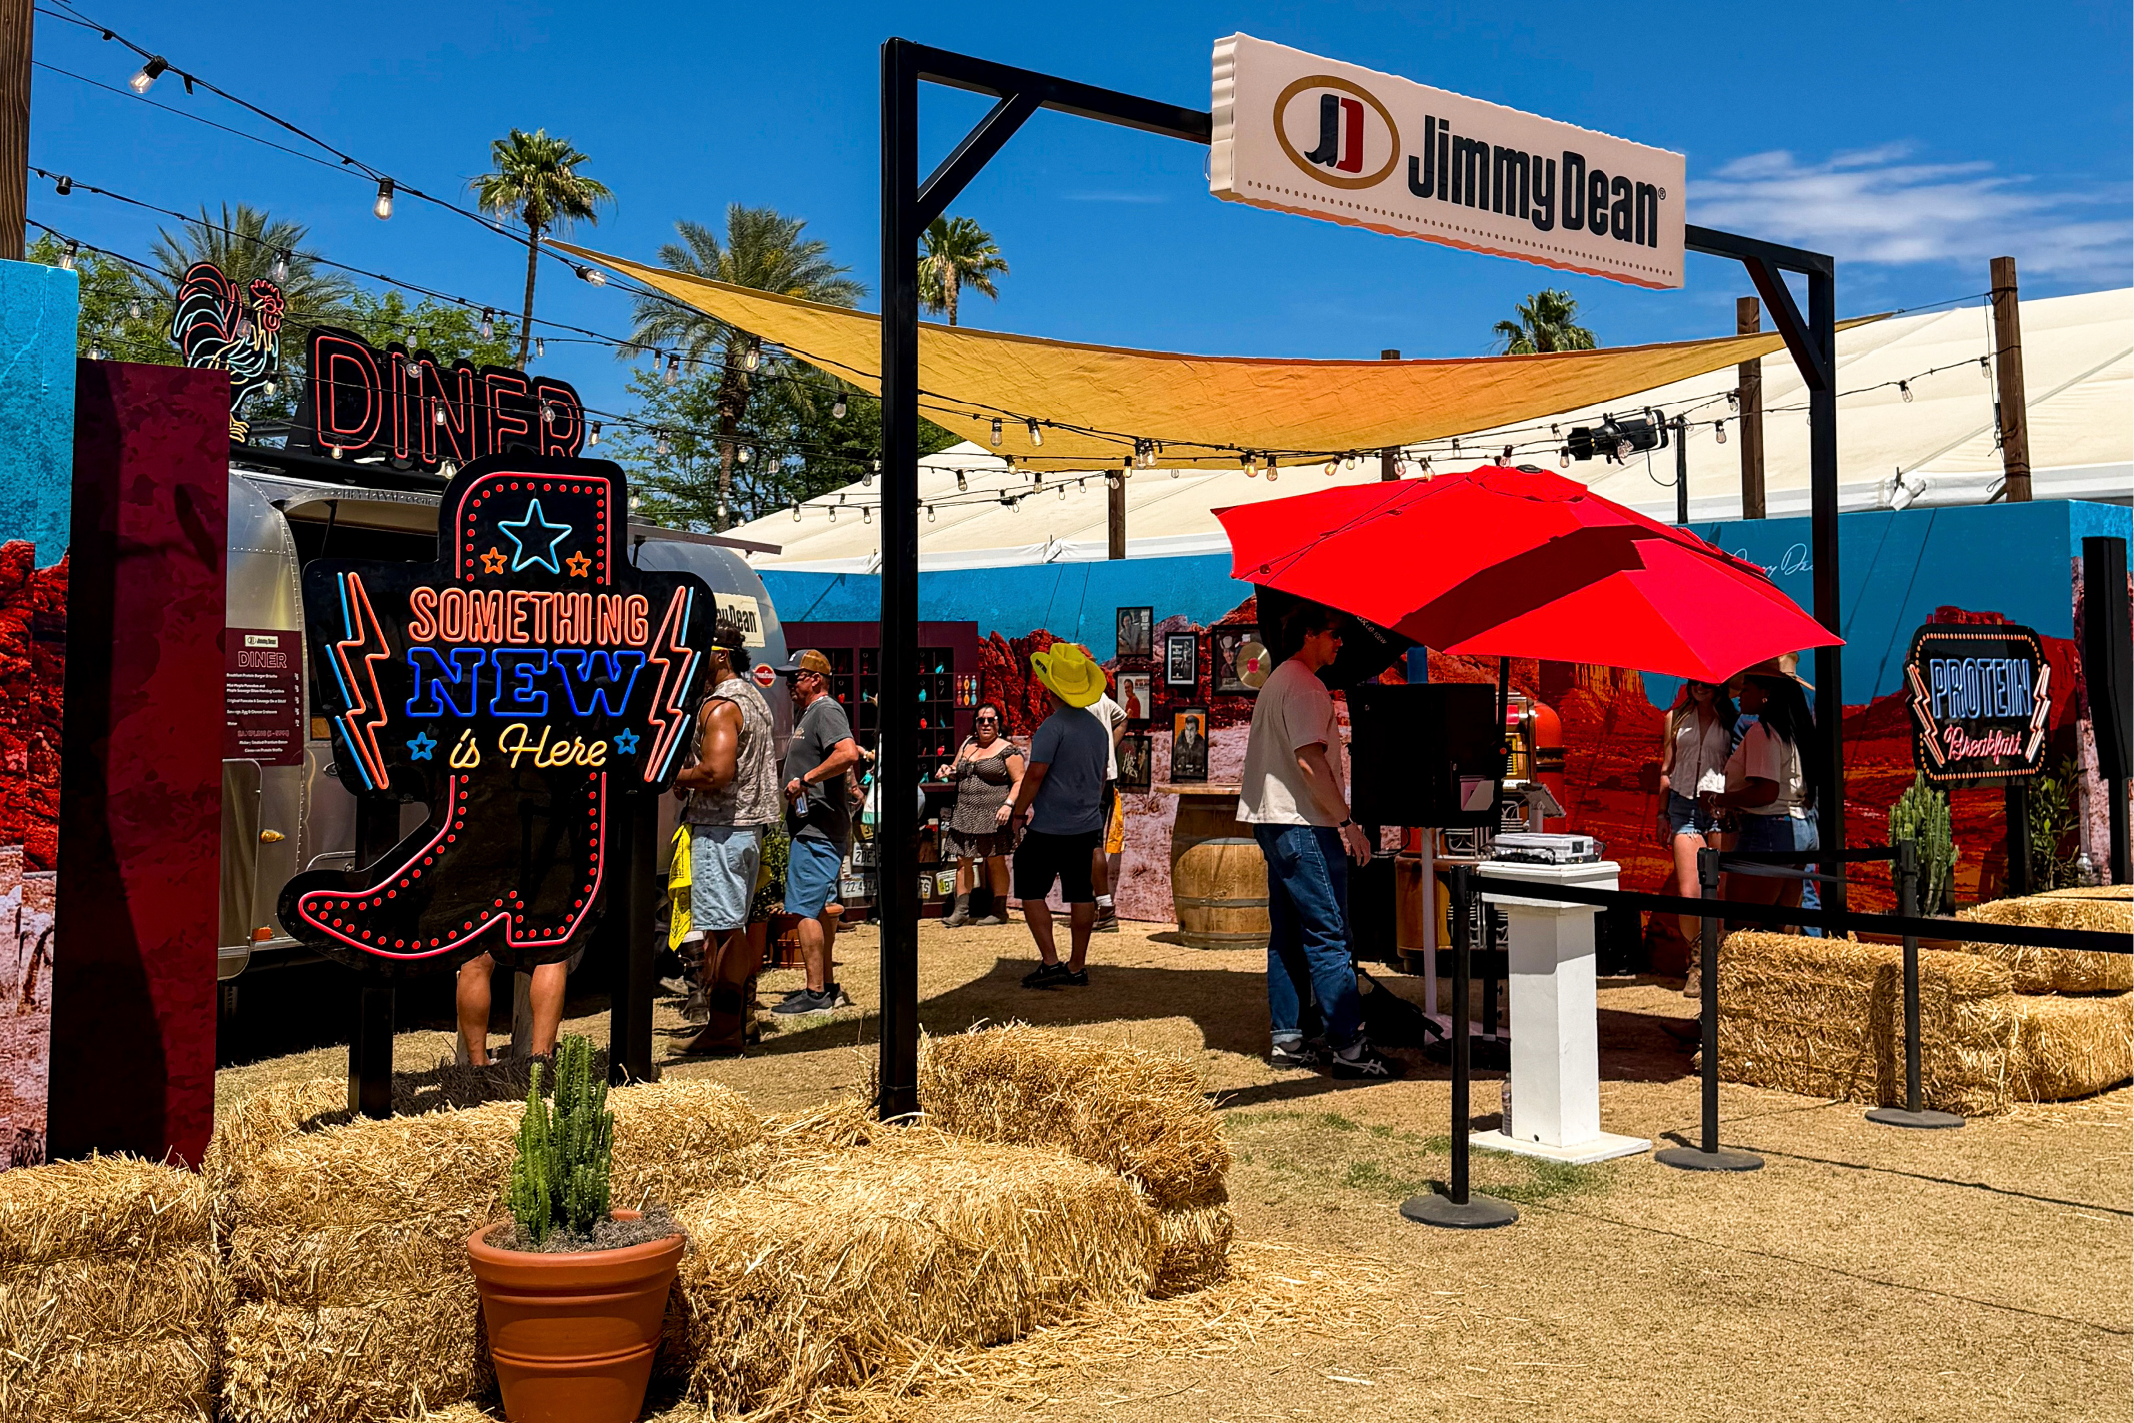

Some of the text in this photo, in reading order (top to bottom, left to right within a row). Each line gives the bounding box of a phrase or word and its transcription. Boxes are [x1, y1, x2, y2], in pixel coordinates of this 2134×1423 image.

[316, 336, 581, 464] DINER
[408, 587, 649, 645] SOMETHING
[238, 651, 287, 668] DINER
[406, 647, 646, 717] NEW
[1929, 658, 2032, 719] PROTEIN
[449, 723, 608, 768] is Here
